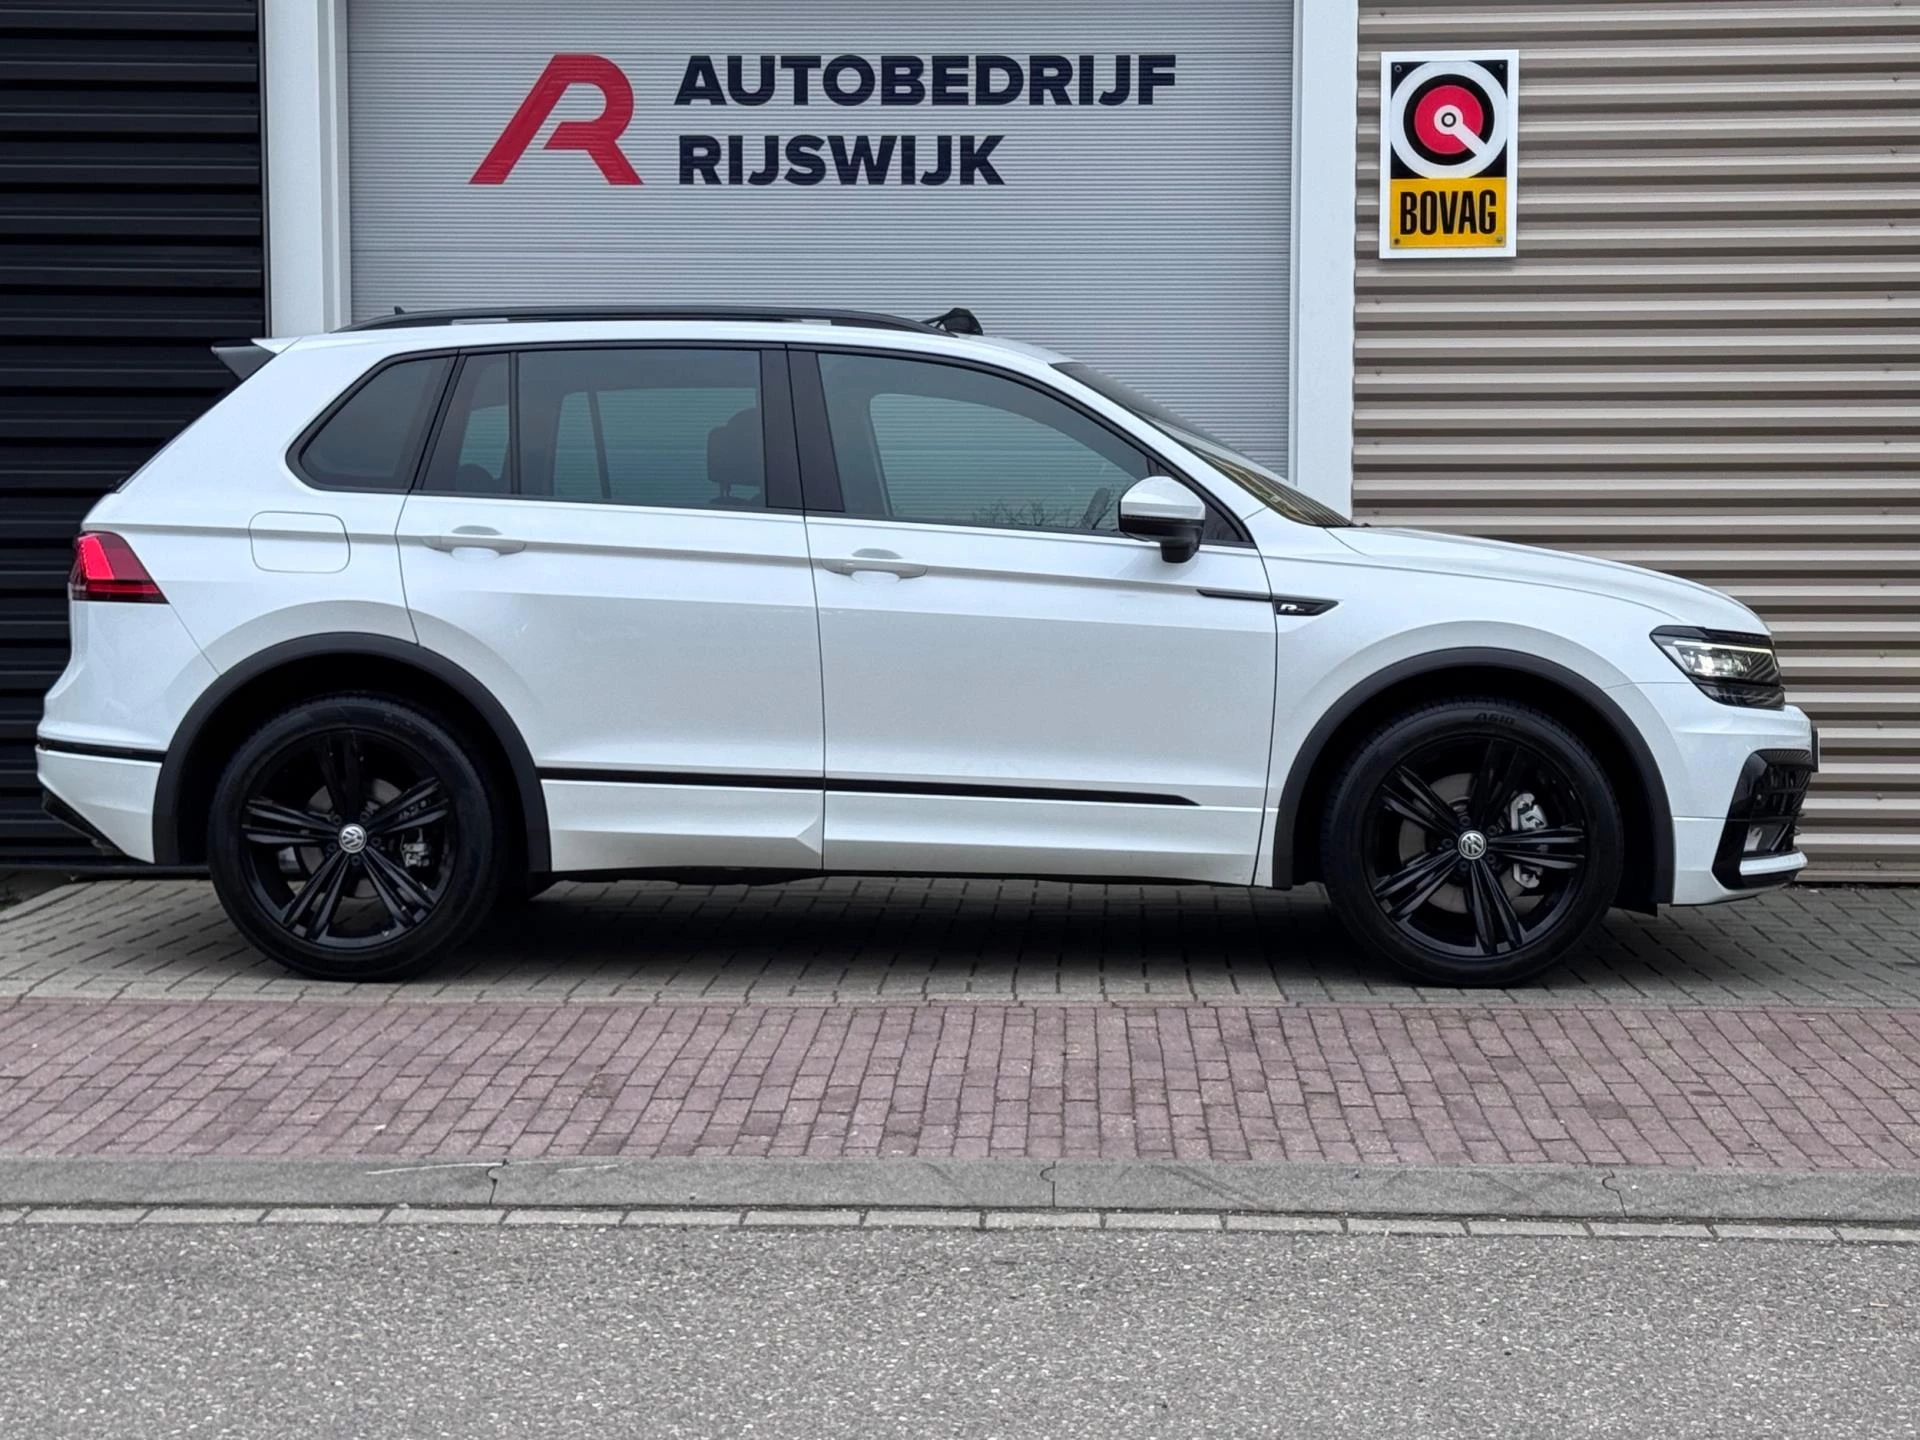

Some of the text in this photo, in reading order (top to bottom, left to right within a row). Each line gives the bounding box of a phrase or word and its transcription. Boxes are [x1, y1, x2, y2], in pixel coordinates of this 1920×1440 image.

[674, 54, 1176, 106] AUTOBEDRIJF
[679, 135, 1005, 185] RIJSWIJK
[1400, 189, 1496, 236] BOVAG
